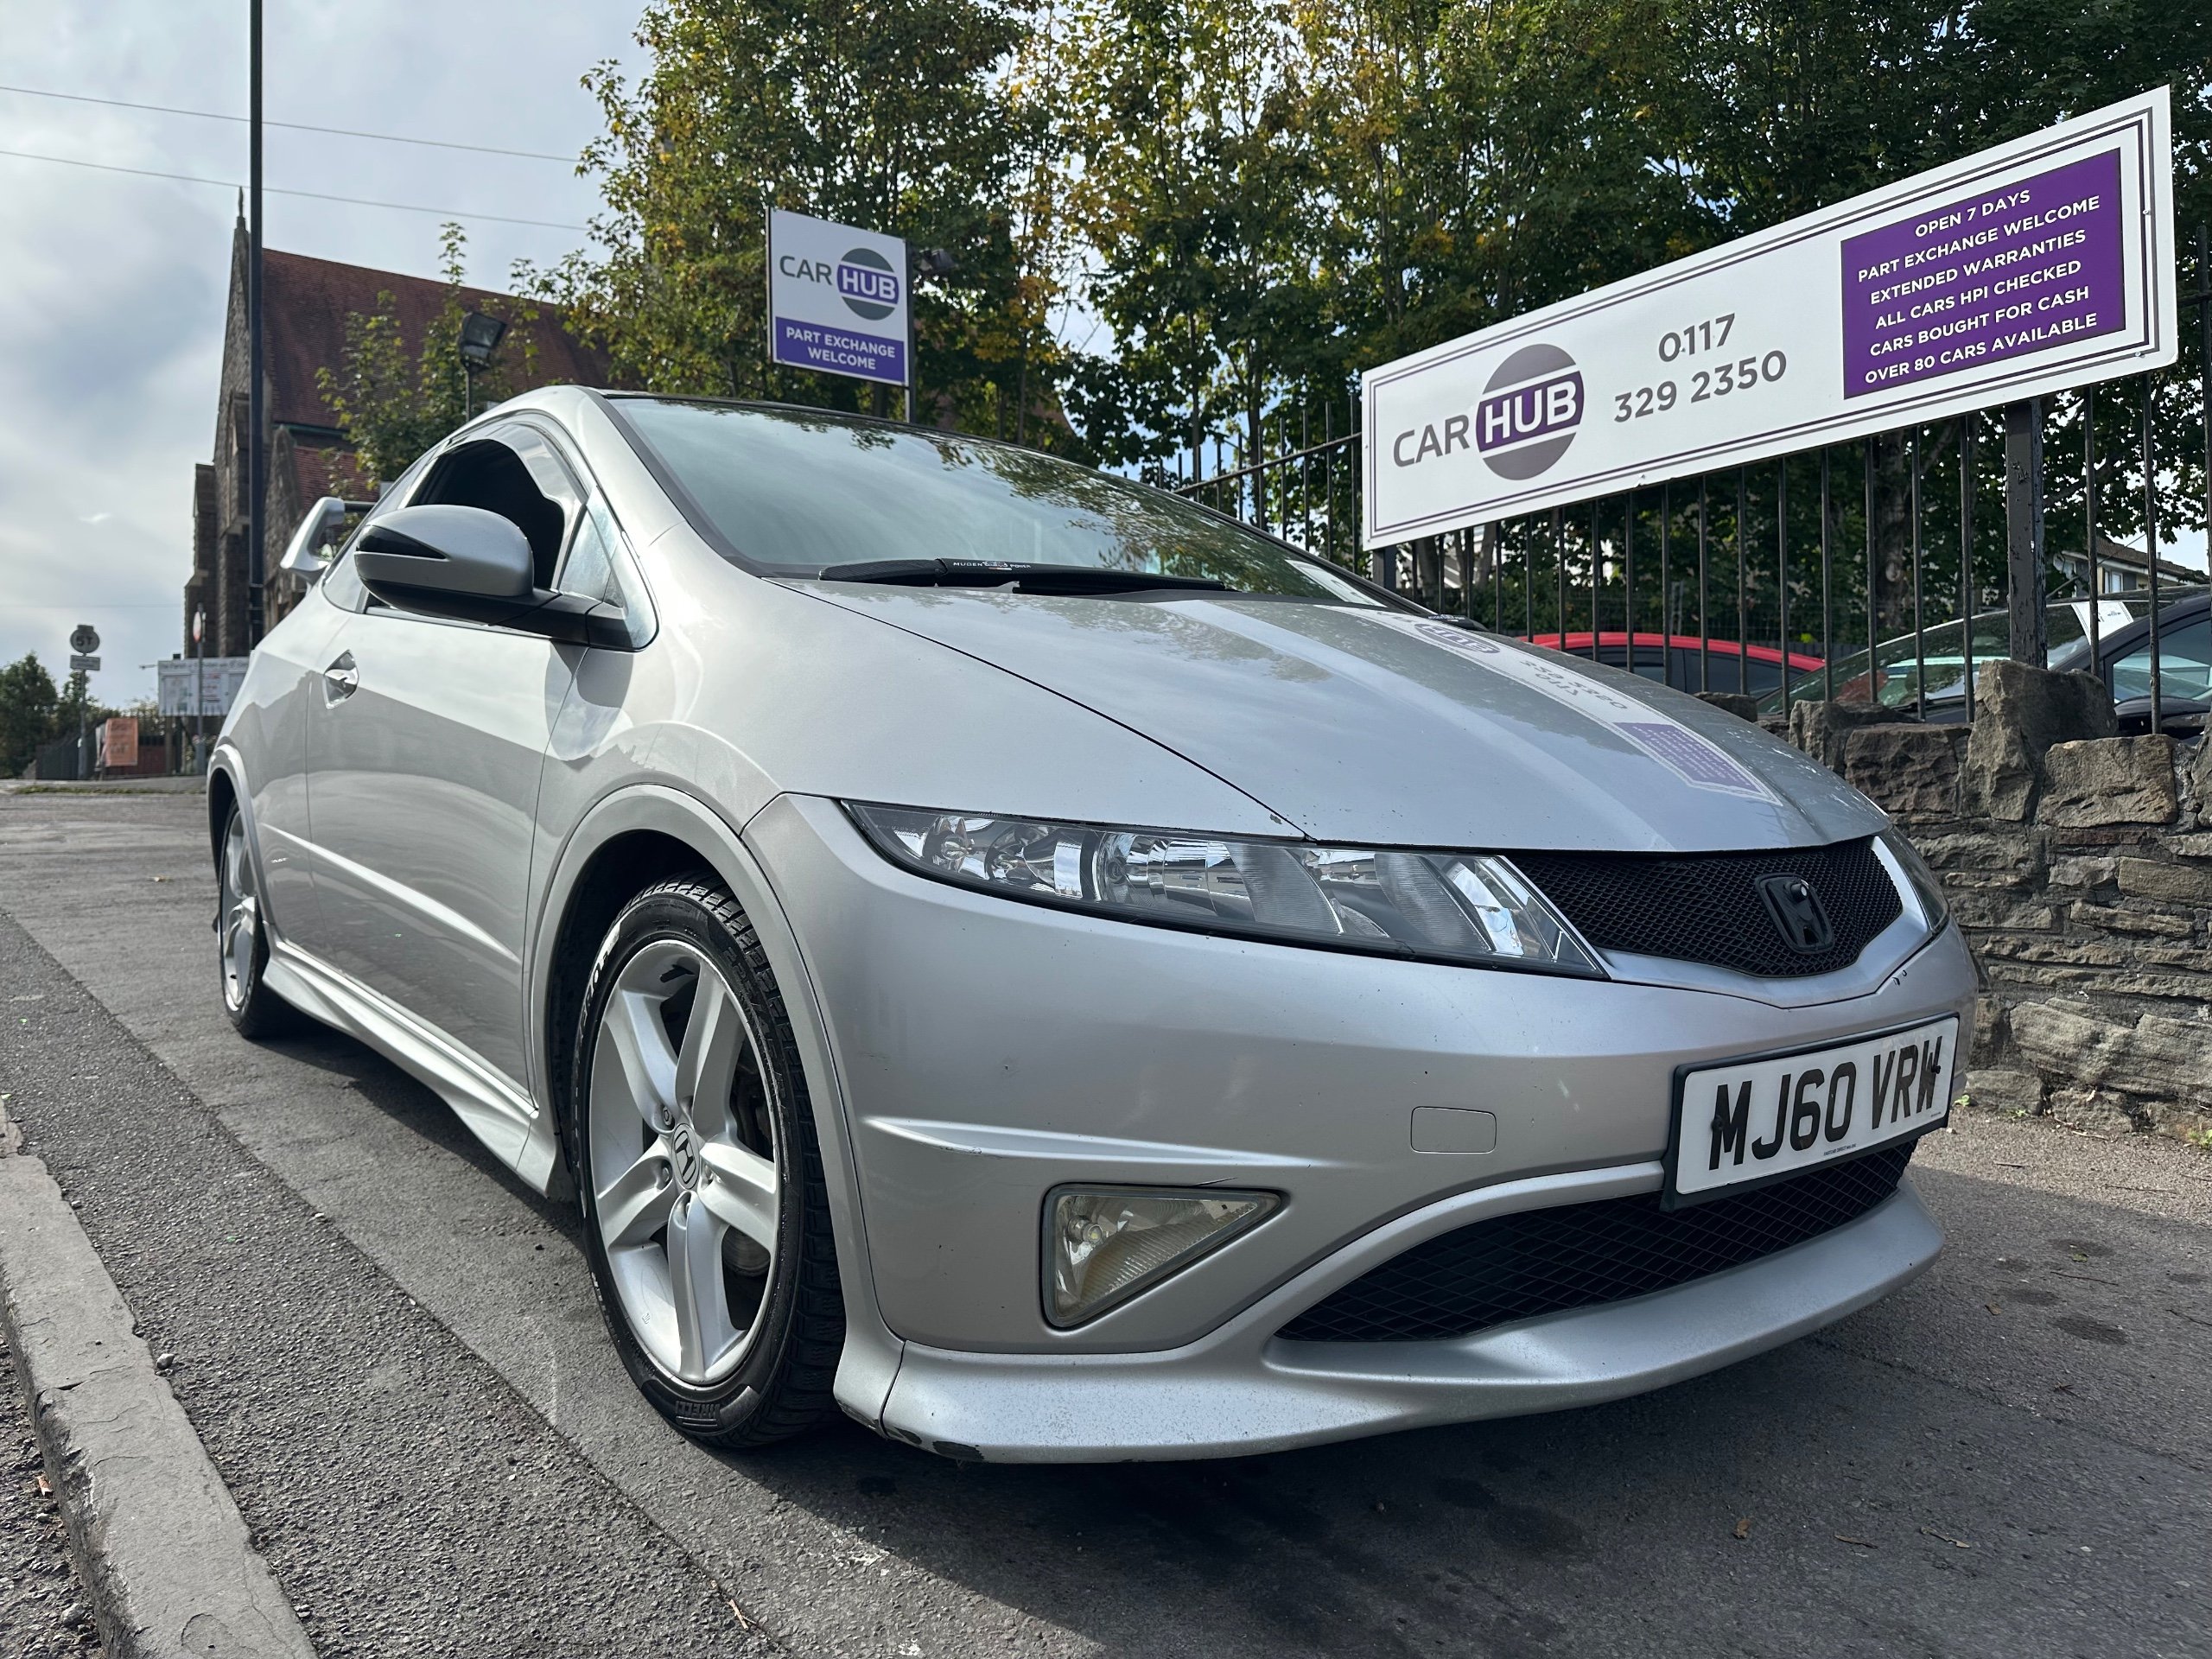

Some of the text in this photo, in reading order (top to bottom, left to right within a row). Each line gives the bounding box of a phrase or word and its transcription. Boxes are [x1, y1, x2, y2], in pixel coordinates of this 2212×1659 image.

[1858, 195, 2100, 283] PART EXCHANGE WELCOME
[1915, 189, 2031, 238] OPEN 7 DAYS
[779, 255, 895, 300] CAR HUB
[1871, 229, 2086, 305] EXTENDED WARRANTIES
[1875, 260, 2082, 329] ALL CARS HPI CHECKED
[785, 325, 896, 359] PART EXCHANGE
[1658, 313, 1736, 362] 0117
[1865, 312, 2097, 384] OVER 80 CARS AVAILABLE
[1870, 285, 2089, 356] CARS BOUGHT FOR CASH
[807, 346, 876, 370] WELCOME
[1613, 350, 1787, 423] 329 2350
[1393, 380, 1578, 467] CAR HUB
[1707, 1035, 1943, 1170] MJ60 VRW
